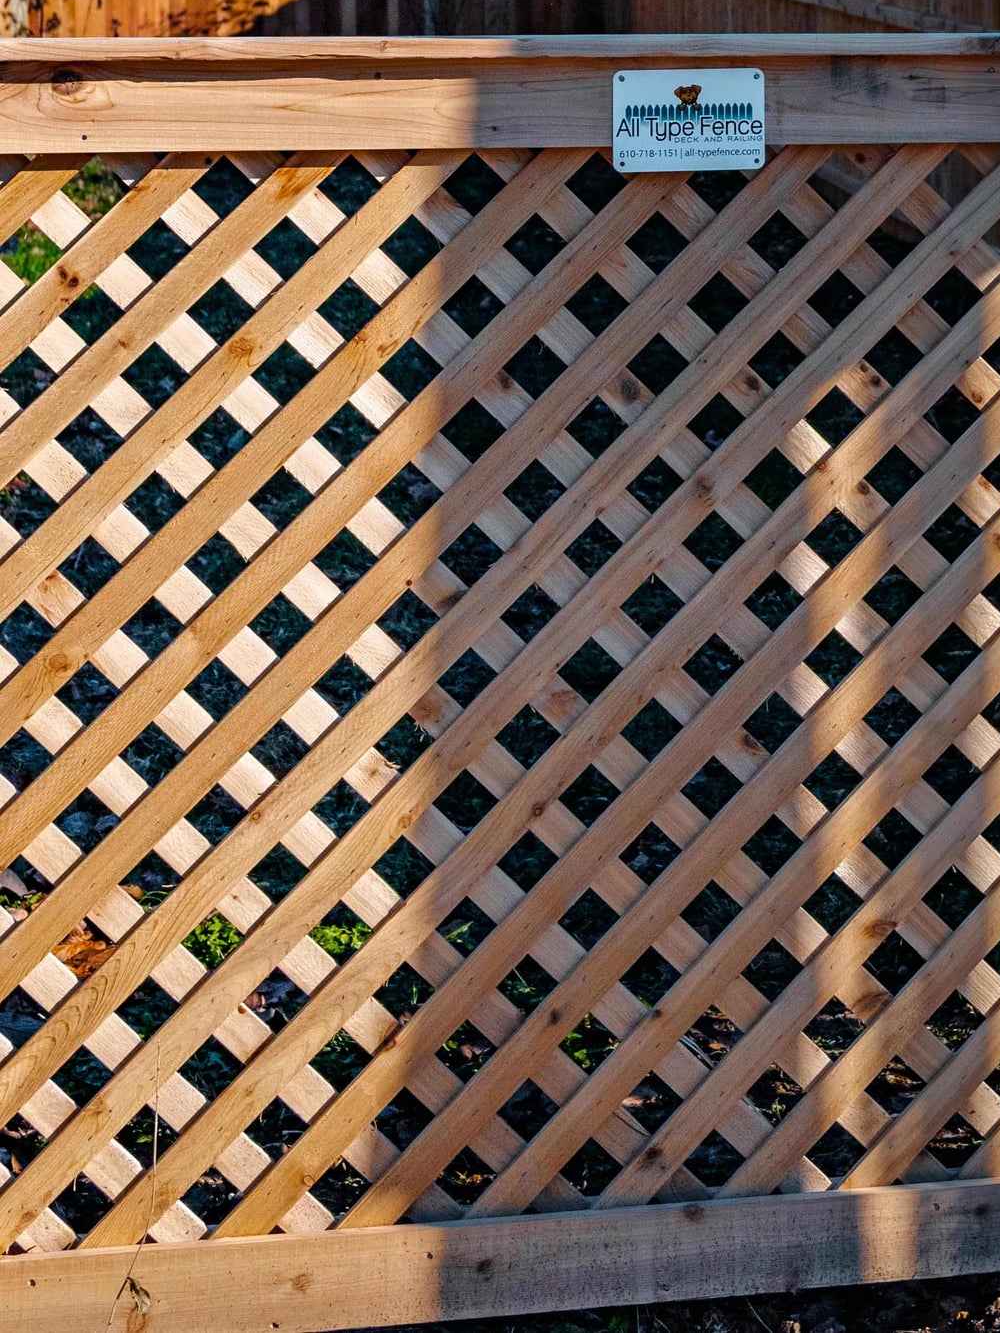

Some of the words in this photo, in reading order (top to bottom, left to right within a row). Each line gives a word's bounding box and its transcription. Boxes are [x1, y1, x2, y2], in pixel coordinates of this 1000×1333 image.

[616, 117, 640, 138] All
[645, 117, 695, 142] Type
[700, 116, 763, 136] Fence
[674, 136, 700, 144] DECK
[619, 149, 678, 158] 610-718-1151
[684, 148, 761, 158] all-typefence.com
